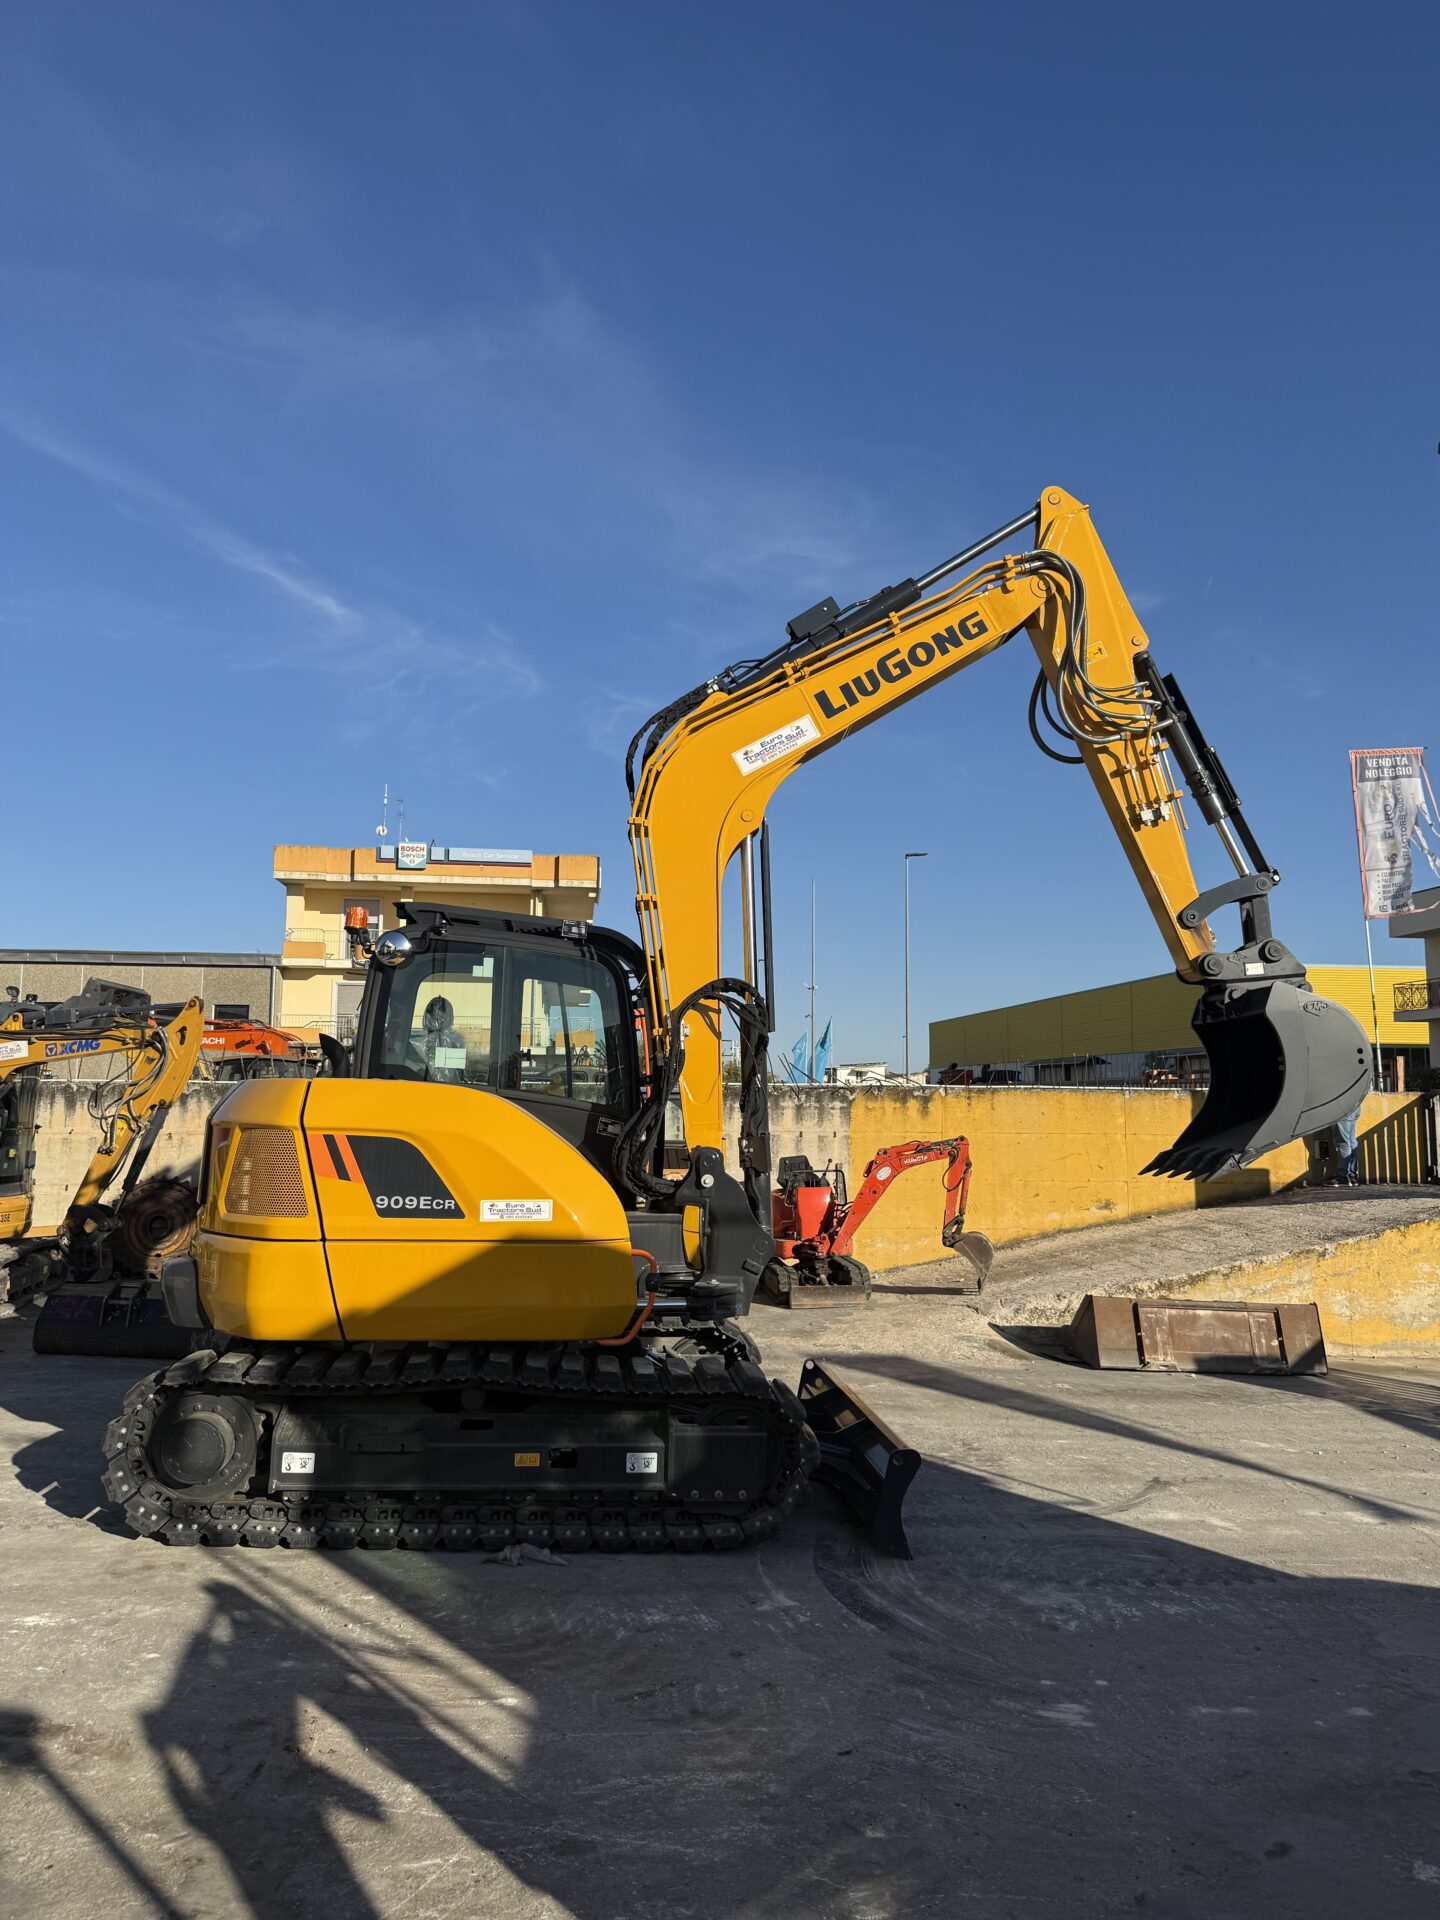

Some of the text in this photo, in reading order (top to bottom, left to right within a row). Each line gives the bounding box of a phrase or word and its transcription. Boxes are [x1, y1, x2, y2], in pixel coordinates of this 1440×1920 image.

[813, 610, 988, 719] LIUGONG
[743, 728, 804, 762] Tractors Sud
[760, 734, 783, 748] Euro
[1365, 766, 1412, 778] NOLEGGIO
[1366, 756, 1408, 768] VENDITA
[1384, 804, 1394, 839] EURO
[1400, 814, 1411, 862] TRACTORS
[58, 1039, 100, 1055] XCMG
